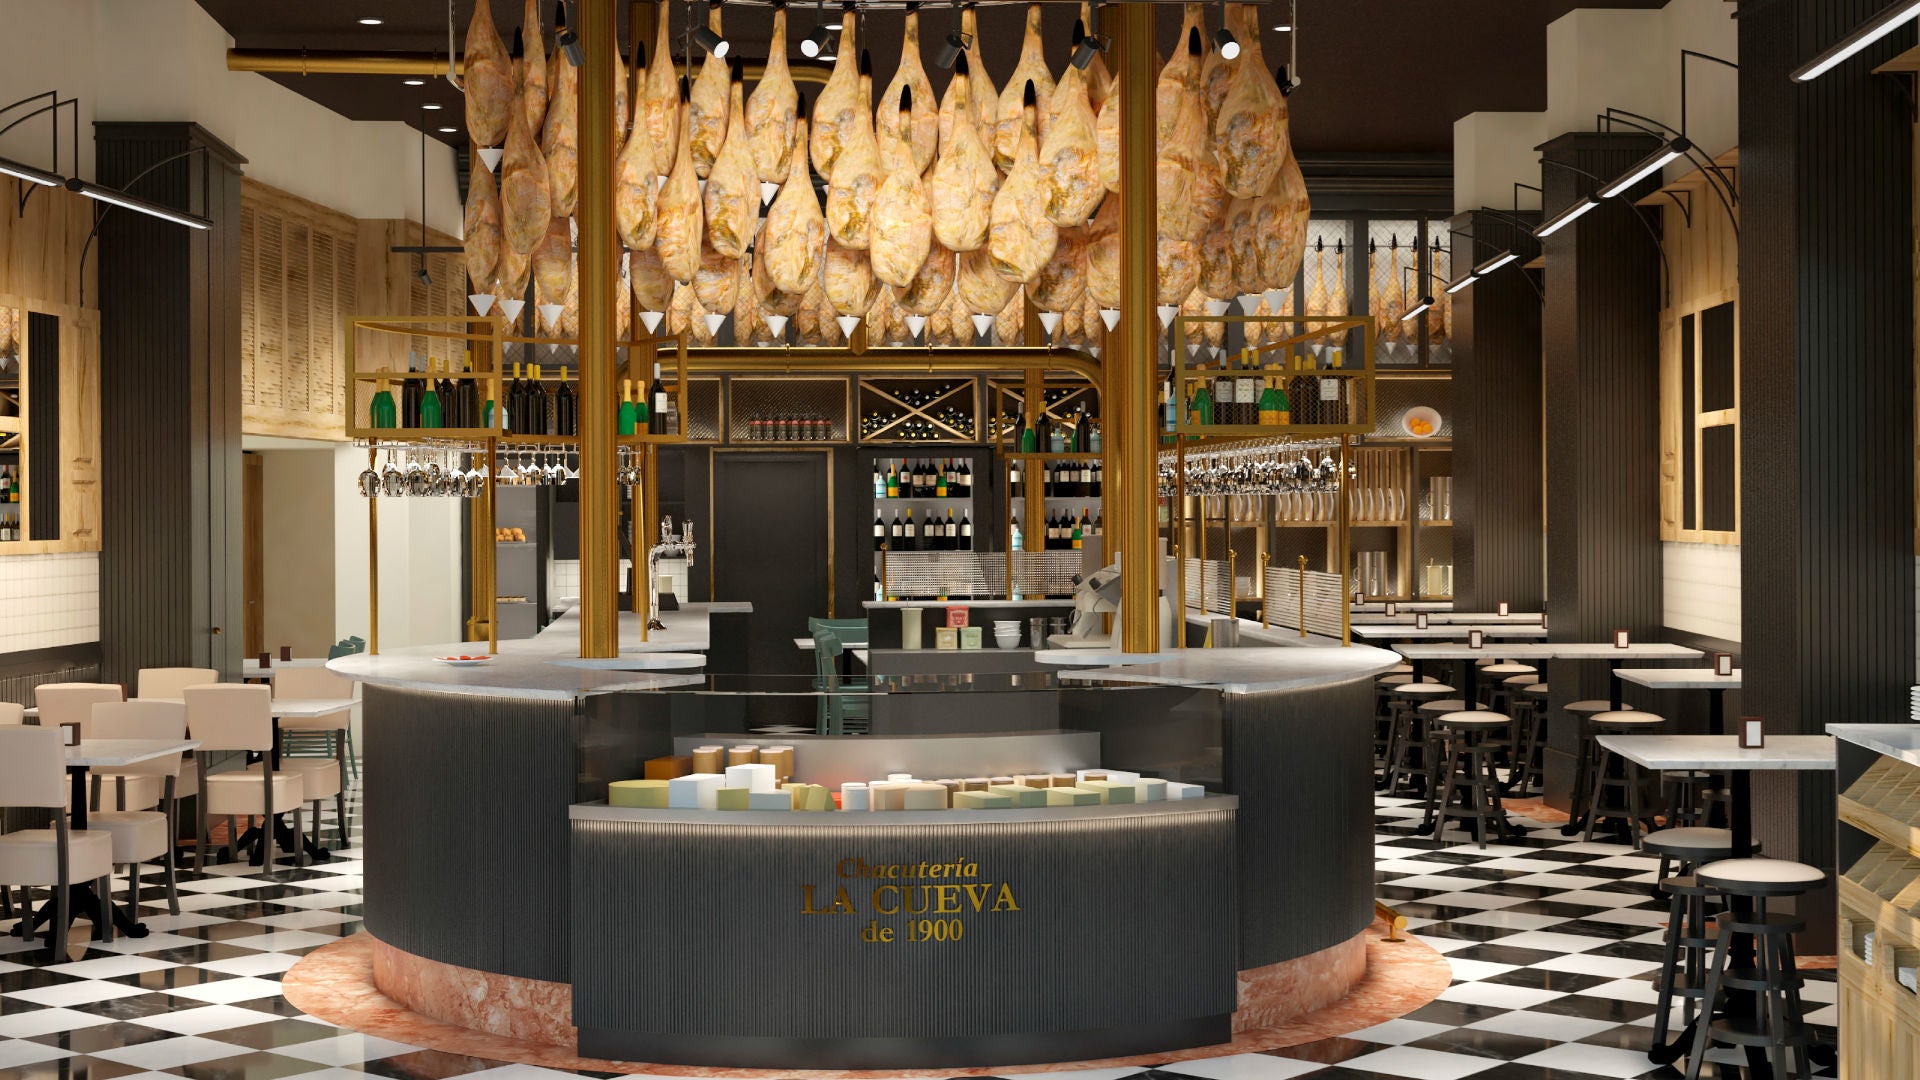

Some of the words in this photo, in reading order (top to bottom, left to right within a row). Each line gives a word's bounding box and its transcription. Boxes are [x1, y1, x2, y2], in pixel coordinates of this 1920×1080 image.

[837, 857, 978, 879] Chacutería
[801, 885, 857, 915] LA
[872, 882, 1021, 915] CUEVA
[861, 920, 894, 943] de
[907, 919, 964, 942] 1900
